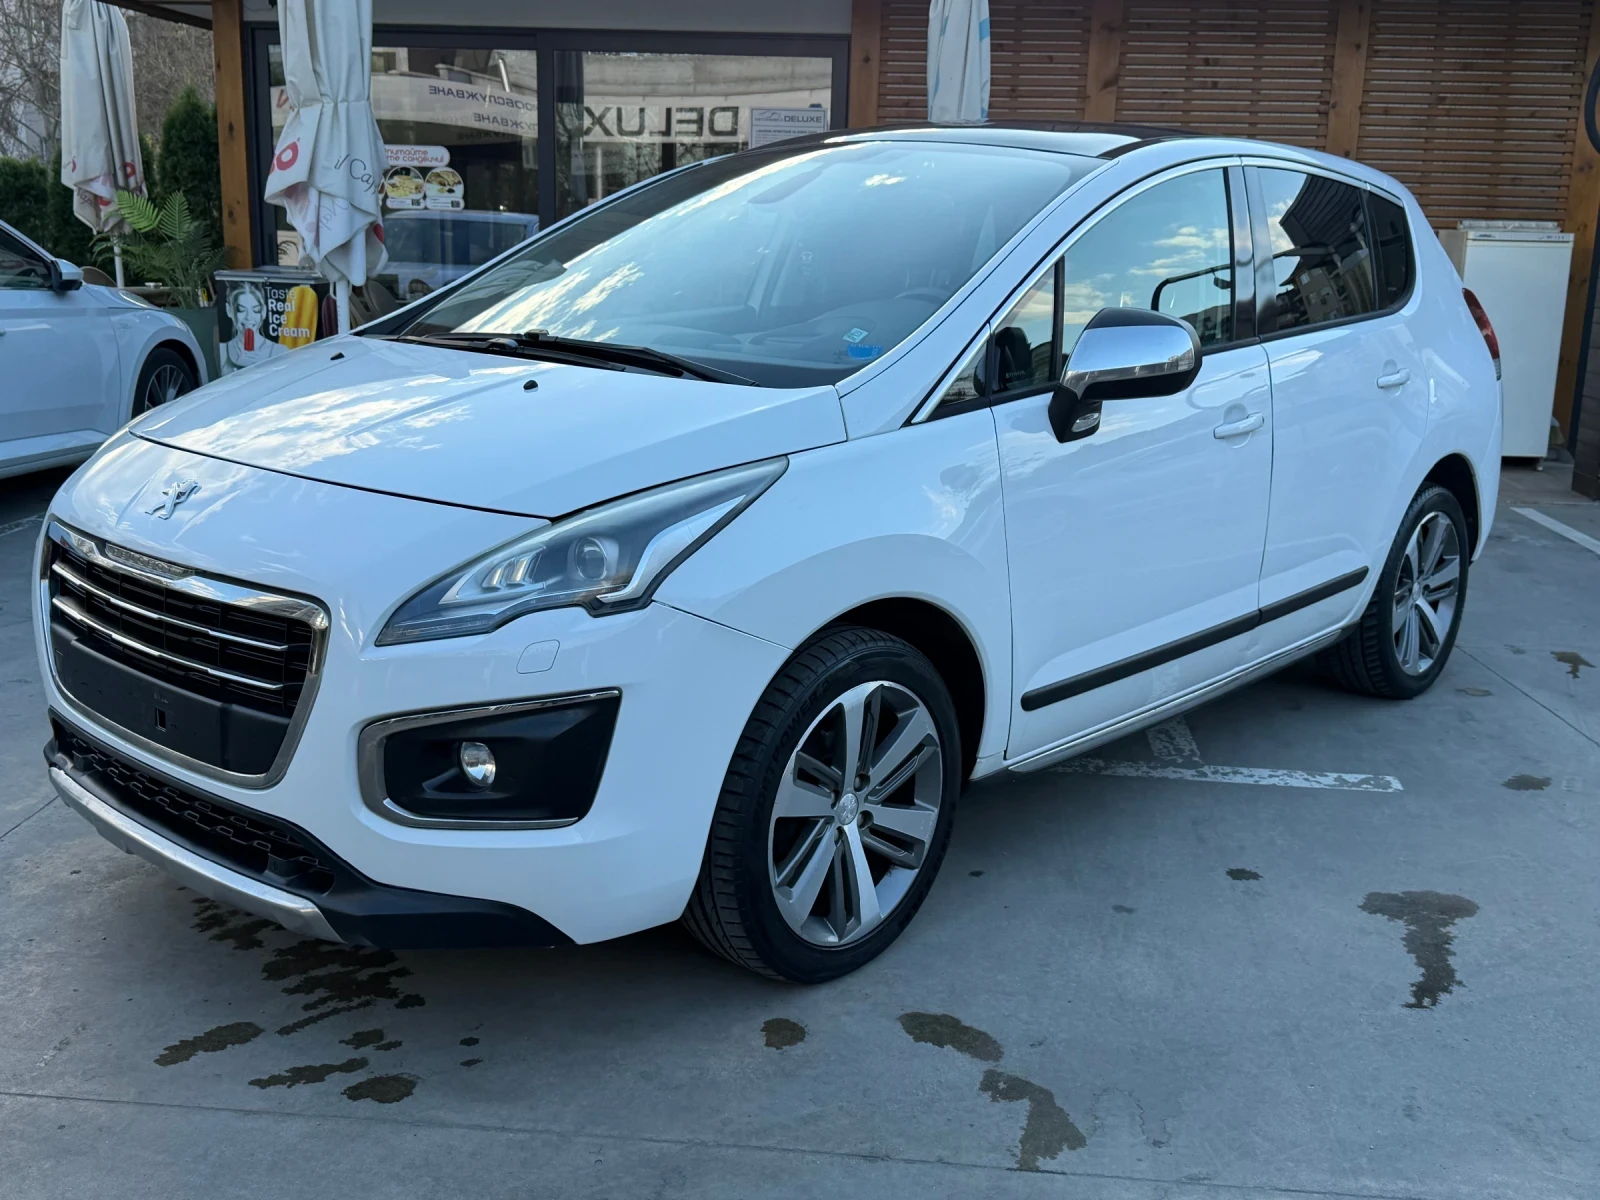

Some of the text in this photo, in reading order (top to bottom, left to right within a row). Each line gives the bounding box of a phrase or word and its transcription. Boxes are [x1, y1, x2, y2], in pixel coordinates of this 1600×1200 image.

[784, 115, 822, 123] DELUXE
[386, 147, 428, 156] питайте
[265, 286, 297, 299] Taste
[268, 299, 295, 312] Real
[268, 311, 287, 325] Ice
[269, 324, 310, 338] Cream
